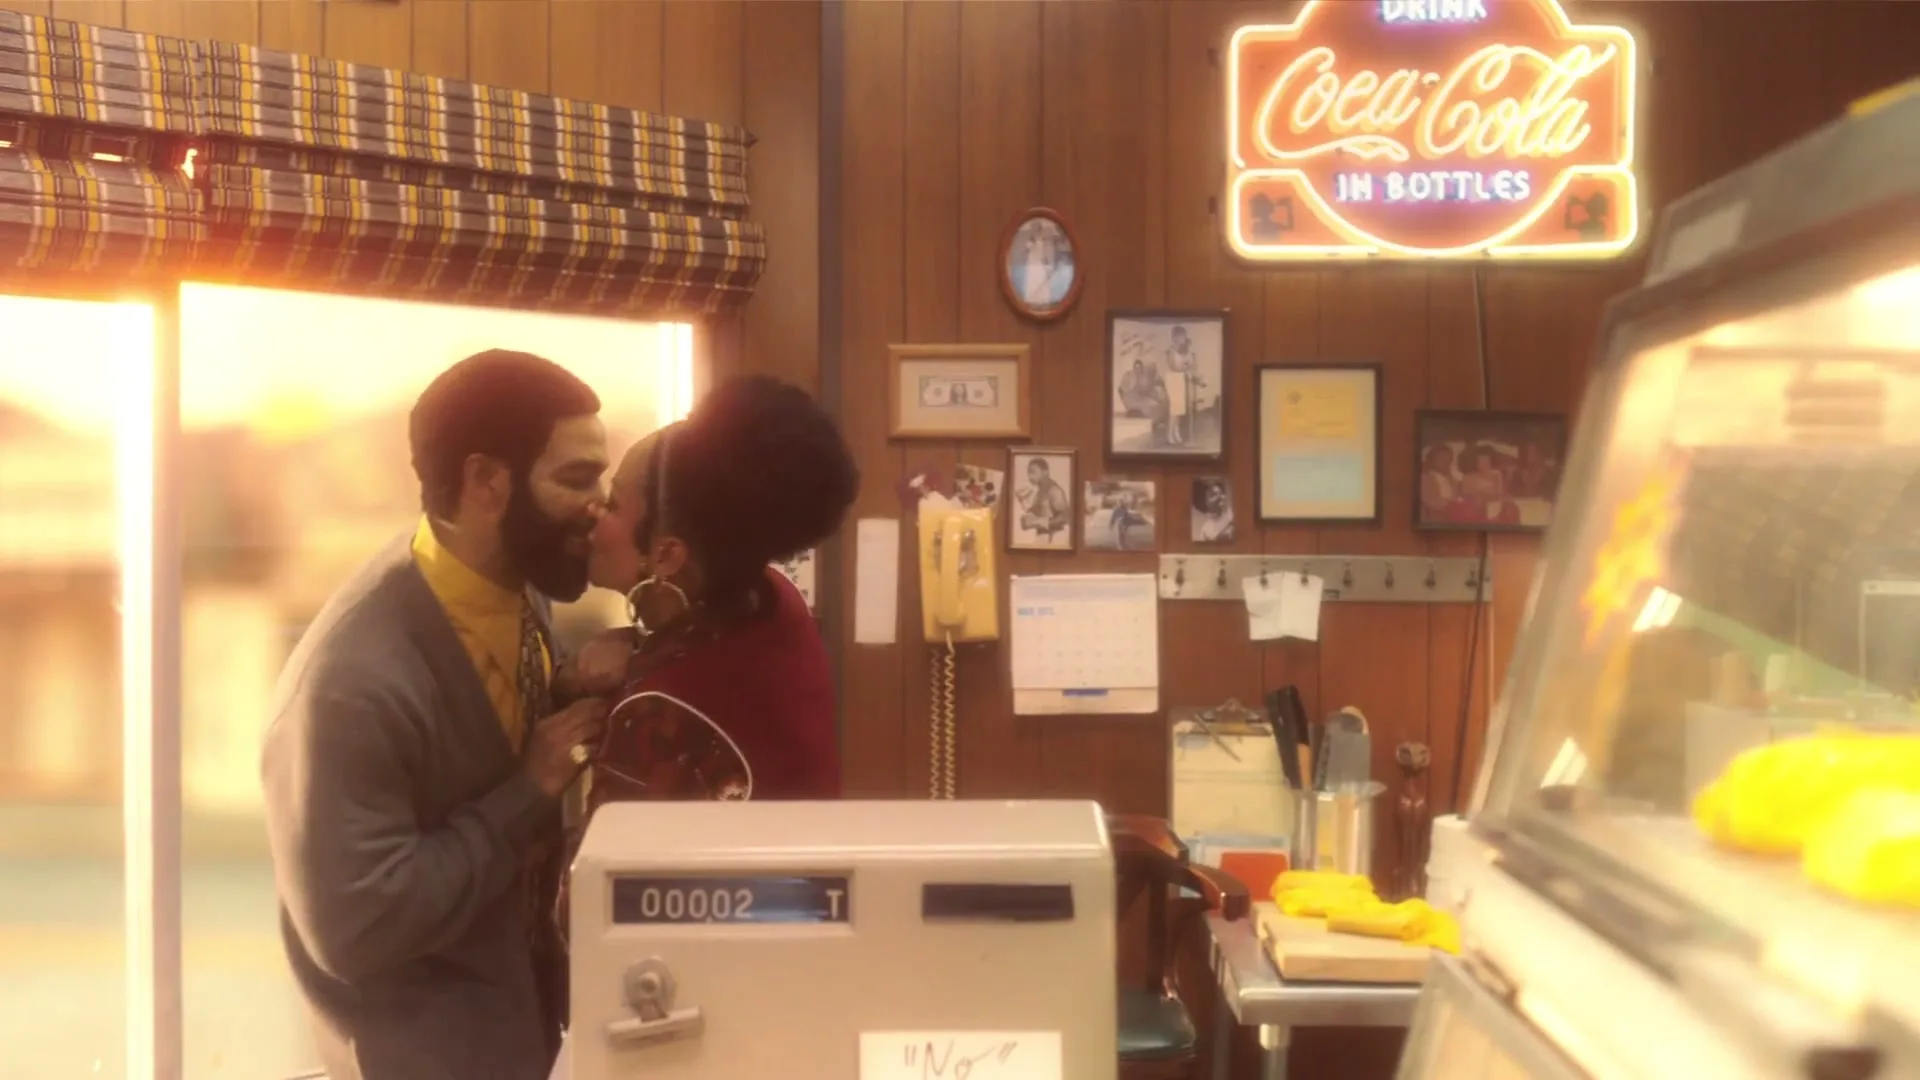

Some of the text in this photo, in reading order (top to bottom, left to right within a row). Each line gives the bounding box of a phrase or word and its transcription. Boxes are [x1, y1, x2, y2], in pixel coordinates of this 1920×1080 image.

[1380, 0, 1488, 22] DRINK
[1254, 43, 1617, 161] Coca-Cola
[1336, 170, 1531, 201] IN BOTTLES
[640, 887, 844, 920] 00002 T
